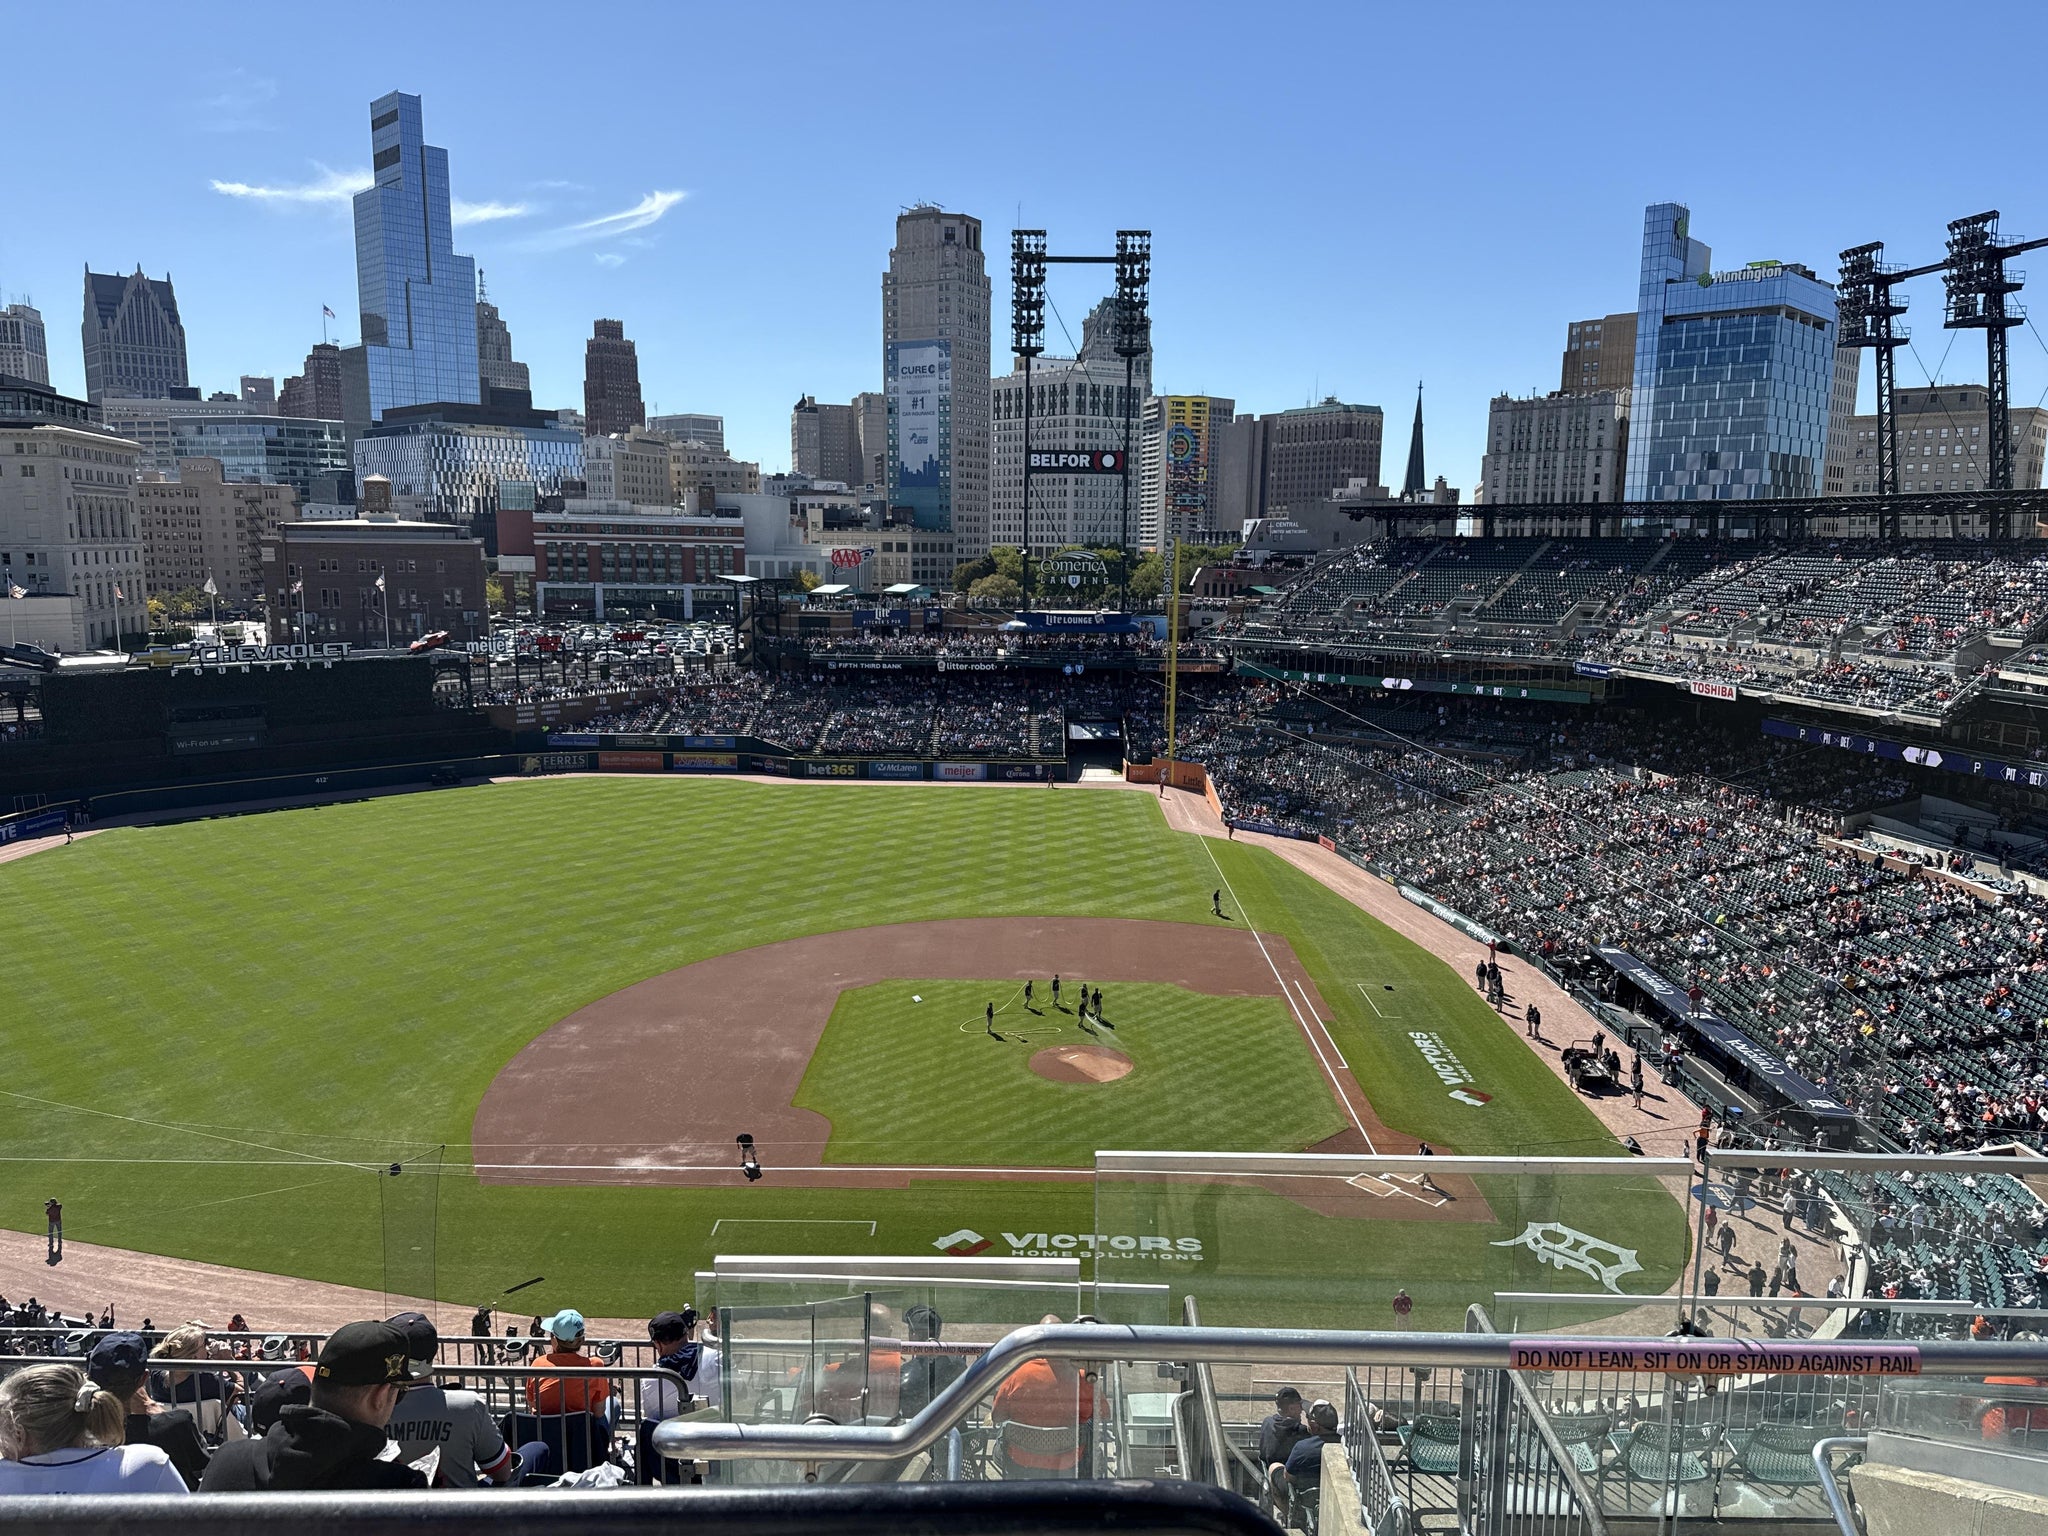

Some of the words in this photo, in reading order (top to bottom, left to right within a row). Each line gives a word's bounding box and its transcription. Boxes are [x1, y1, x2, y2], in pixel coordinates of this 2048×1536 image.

[1713, 266, 1782, 284] Huntington
[901, 365, 927, 375] CURE
[911, 396, 925, 410] #1
[1030, 453, 1091, 467] BELFOR
[833, 549, 860, 567] AAA
[1040, 575, 1109, 587] LANDING
[1045, 614, 1063, 625] Lite
[1063, 616, 1093, 624] LOUNGE
[200, 642, 353, 662] CHEVROLET
[171, 661, 332, 677] FOUNTAIN
[1692, 681, 1734, 698] TOSHIBA
[176, 740, 198, 749] Wi-Fi
[1823, 733, 1831, 744] PIT
[1840, 737, 1849, 748] DET
[543, 755, 586, 766] FERRIS
[886, 763, 917, 772] McLaren
[808, 763, 855, 775] bet365
[944, 766, 976, 777] meijer
[1006, 769, 1030, 777] Corona
[2006, 767, 2016, 781] PIT
[2029, 773, 2043, 786] DET
[0, 825, 17, 840] TE
[1243, 821, 1259, 830] FIFTH
[1261, 825, 1278, 834] THIRD
[1407, 1032, 1464, 1085] VICTORS
[1001, 1232, 1203, 1252] VICTORS
[1011, 1250, 1073, 1258] HOME
[1079, 1250, 1205, 1261] SOLUTIONS
[901, 1345, 913, 1353] SIT
[935, 1346, 956, 1354] STAND
[957, 1346, 984, 1354] AGAINST
[1518, 1350, 1542, 1367] DO
[1548, 1350, 1583, 1367] NOT
[1589, 1351, 1638, 1370] LEAN,
[1644, 1352, 1671, 1369] SIT
[1677, 1353, 1701, 1369] ON
[1707, 1353, 1731, 1370] OR
[1737, 1353, 1794, 1371] STAND
[1798, 1354, 1874, 1372] AGAINST
[1880, 1356, 1917, 1373] RAIL
[384, 1420, 453, 1441] AMPIONS
